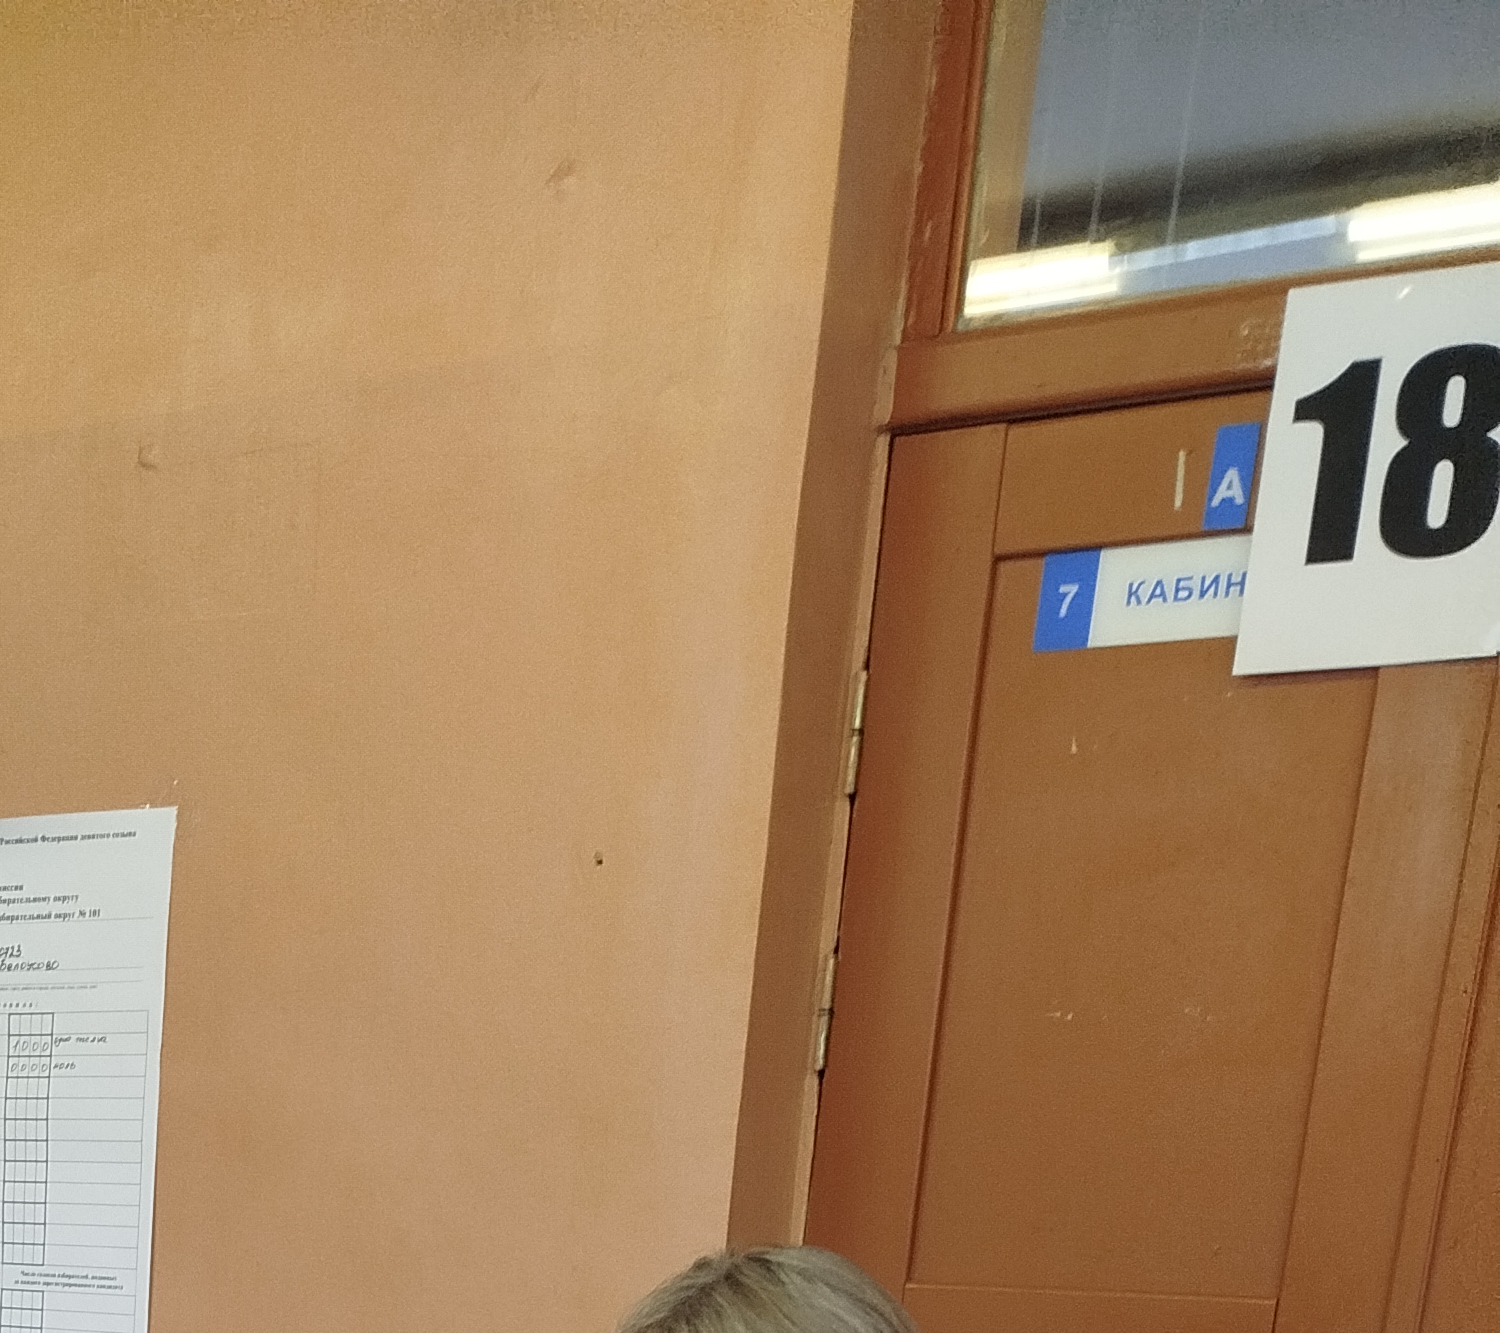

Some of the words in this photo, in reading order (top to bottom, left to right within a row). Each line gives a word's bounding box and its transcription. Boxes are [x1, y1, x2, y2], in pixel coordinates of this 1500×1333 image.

[1293, 343, 1500, 566] 18
[1058, 583, 1079, 618] 7
[1125, 570, 1246, 607] КАБИН
[53, 895, 78, 904] округу
[54, 912, 75, 922] округ
[78, 910, 86, 918] №
[89, 909, 100, 918] 101
